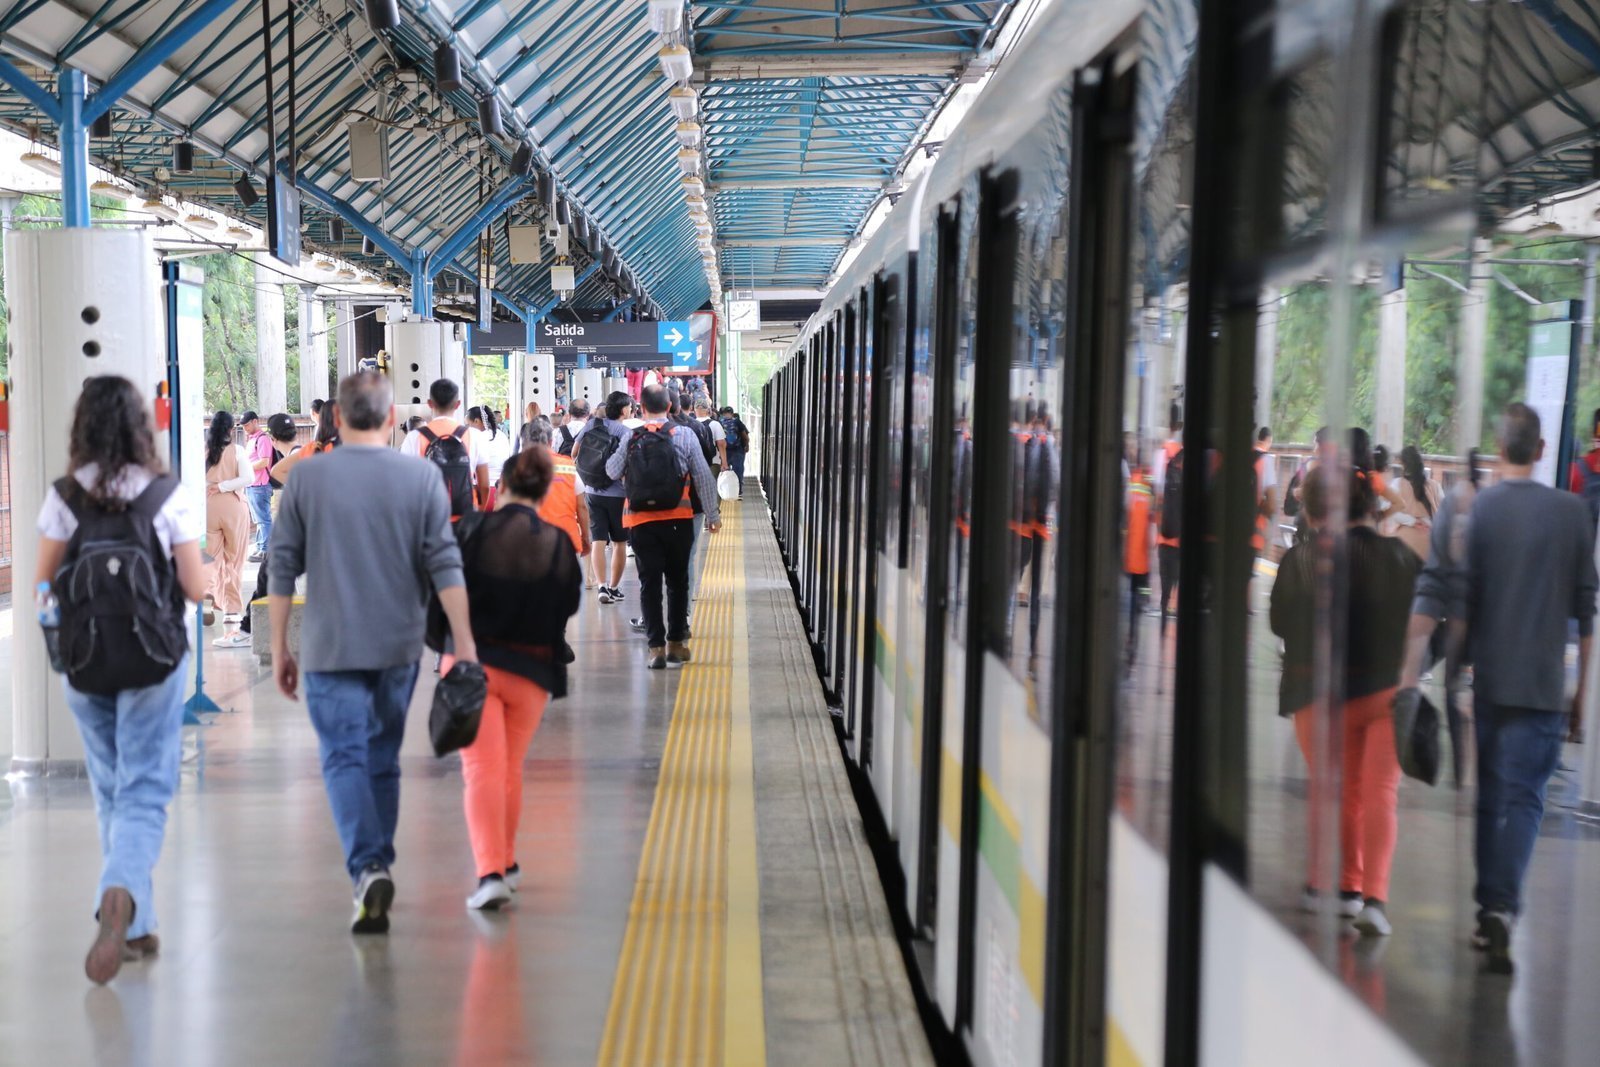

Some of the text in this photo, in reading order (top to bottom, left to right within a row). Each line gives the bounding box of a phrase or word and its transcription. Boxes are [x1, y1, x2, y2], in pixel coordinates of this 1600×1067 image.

[544, 323, 585, 336] Salida
[555, 337, 574, 346] Exit
[593, 354, 608, 362] Exit
